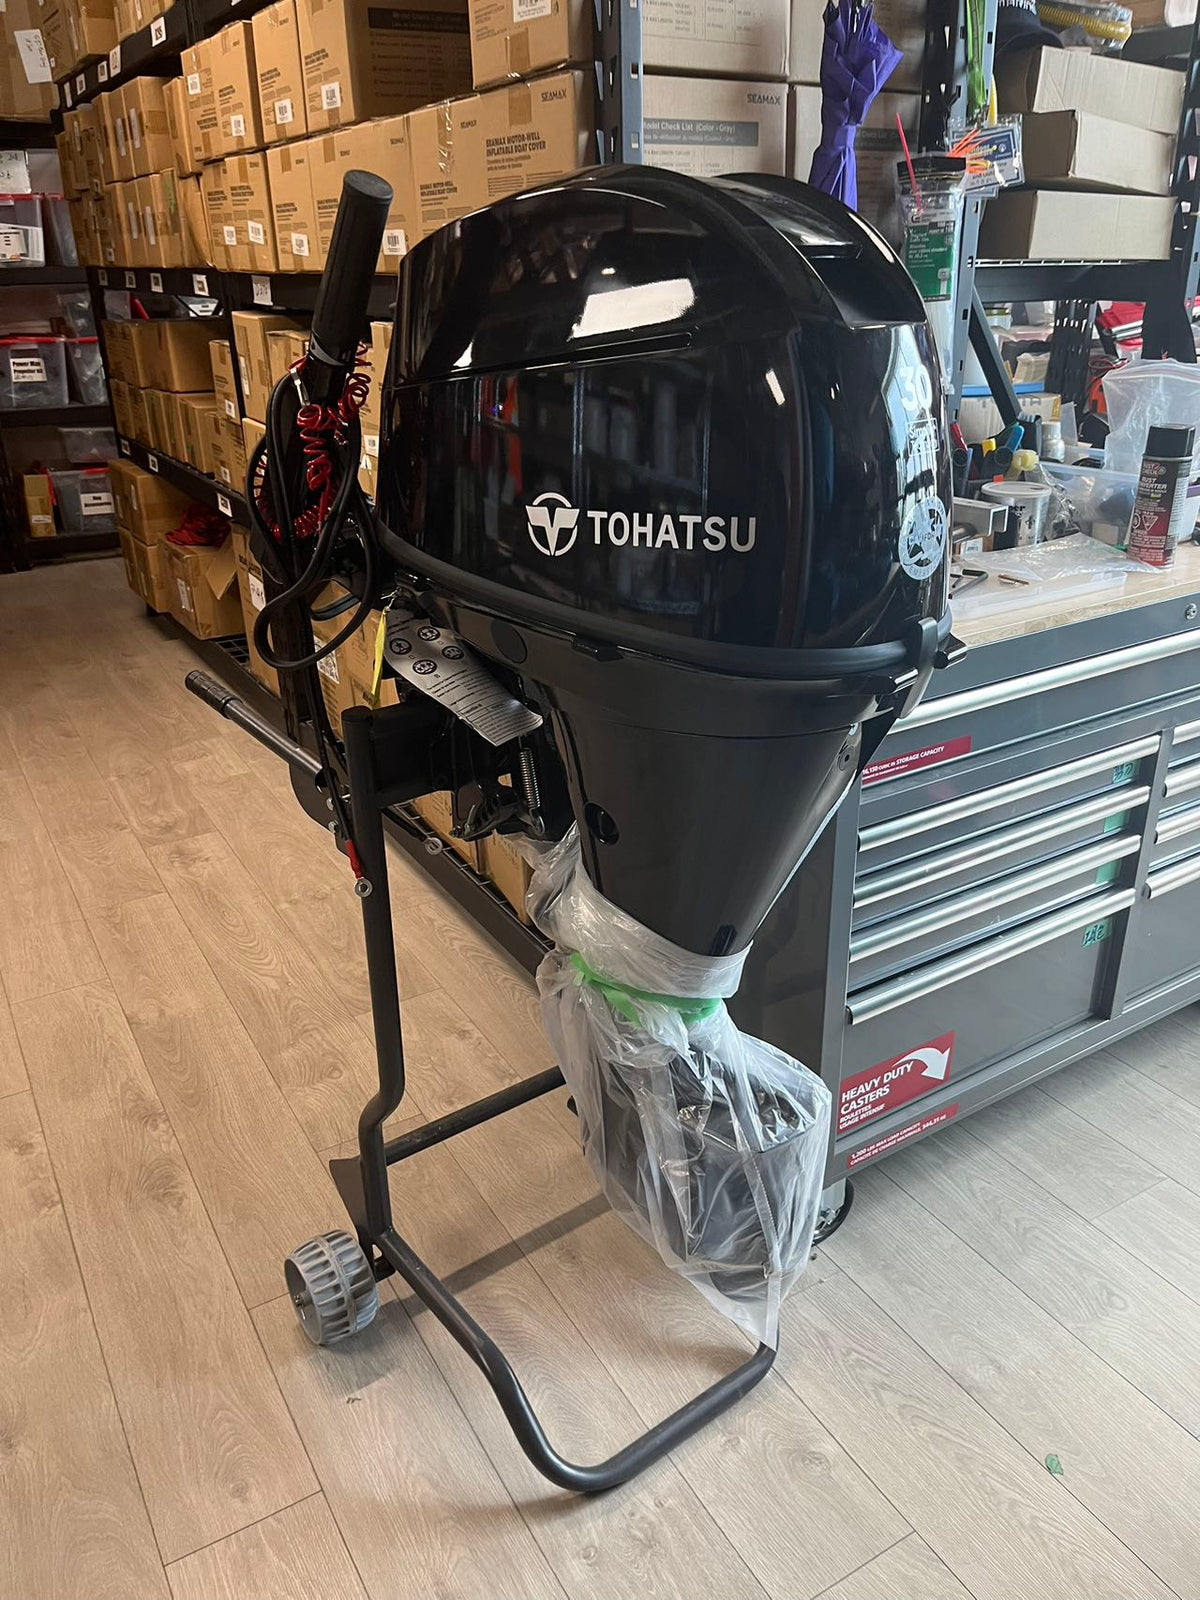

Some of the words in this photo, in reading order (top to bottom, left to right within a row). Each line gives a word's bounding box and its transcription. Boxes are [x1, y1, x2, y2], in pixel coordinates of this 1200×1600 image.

[541, 89, 567, 102] SEAMAX
[747, 93, 781, 105] SEAMAX
[661, 121, 680, 131] Check
[681, 122, 693, 132] List
[486, 137, 506, 148] SEAMAX
[507, 132, 541, 143] MOTOR-WELL
[486, 144, 514, 157] INFLATABLE
[514, 143, 528, 153] BOAT
[528, 140, 546, 152] COVER
[587, 510, 757, 553] TOHATSU
[896, 753, 919, 765] STORAGE
[919, 746, 945, 758] CAPACITY
[841, 1076, 881, 1103] HEAVY
[883, 1061, 914, 1084] DUTY
[841, 1084, 890, 1115] CASTERS
[839, 1104, 872, 1124] ROULETTES
[839, 1116, 860, 1130] USAGE
